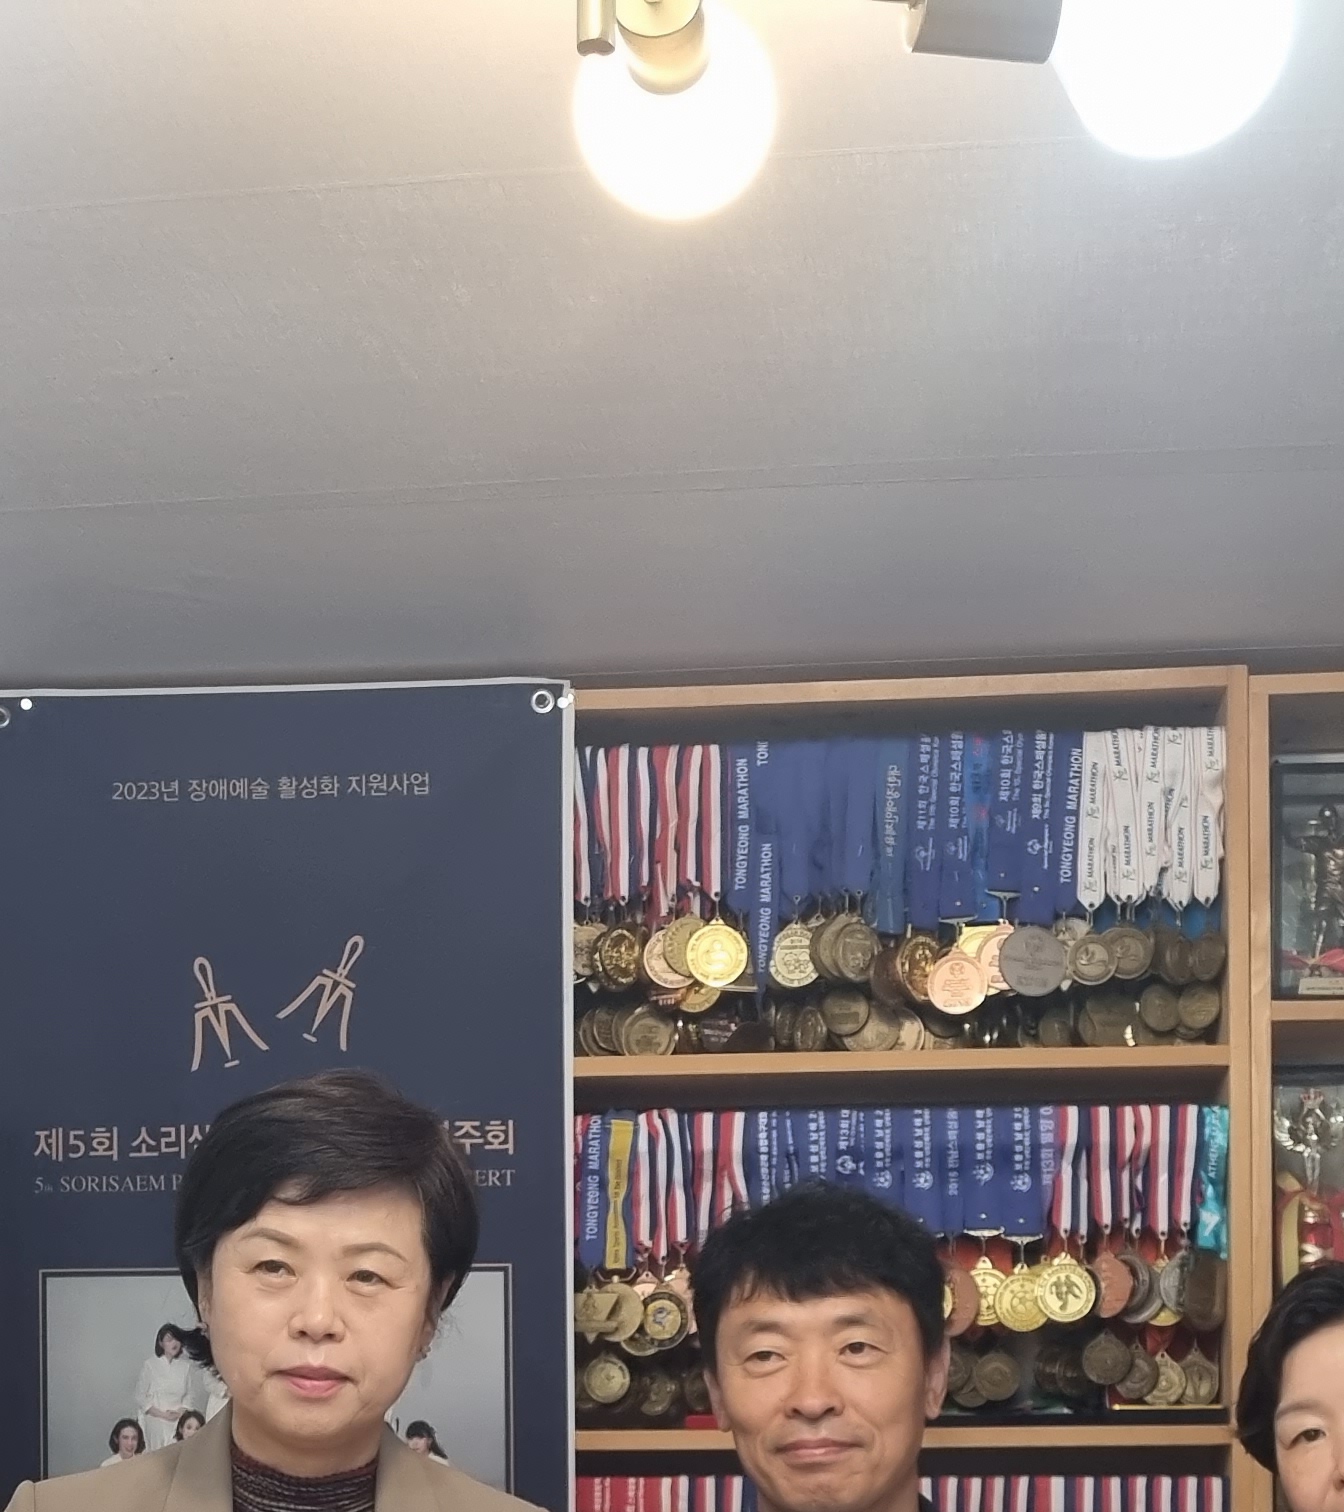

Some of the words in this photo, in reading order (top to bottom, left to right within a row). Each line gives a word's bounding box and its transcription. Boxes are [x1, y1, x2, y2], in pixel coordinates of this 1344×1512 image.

[112, 779, 180, 801] 2023년
[187, 777, 271, 800] 장애예술
[277, 775, 340, 799] 활성화
[346, 772, 430, 796] 지원사업
[737, 758, 748, 821] MARATHON
[1088, 761, 1098, 804] MARATHON
[1060, 815, 1076, 884] TONGYEONG
[1068, 748, 1083, 810] MARATHON
[1147, 801, 1155, 843] MARATHON
[1200, 815, 1209, 856] MARATHON
[735, 825, 749, 891] TONGYEONG
[759, 843, 772, 903] MARATHON
[758, 908, 771, 972] TONGYEONG
[34, 1126, 118, 1162] 제5회
[443, 1119, 514, 1155] 주회
[60, 1175, 165, 1193] SORISAEM
[475, 1169, 515, 1187] ERT
[585, 1175, 599, 1241] TONGYEONG
